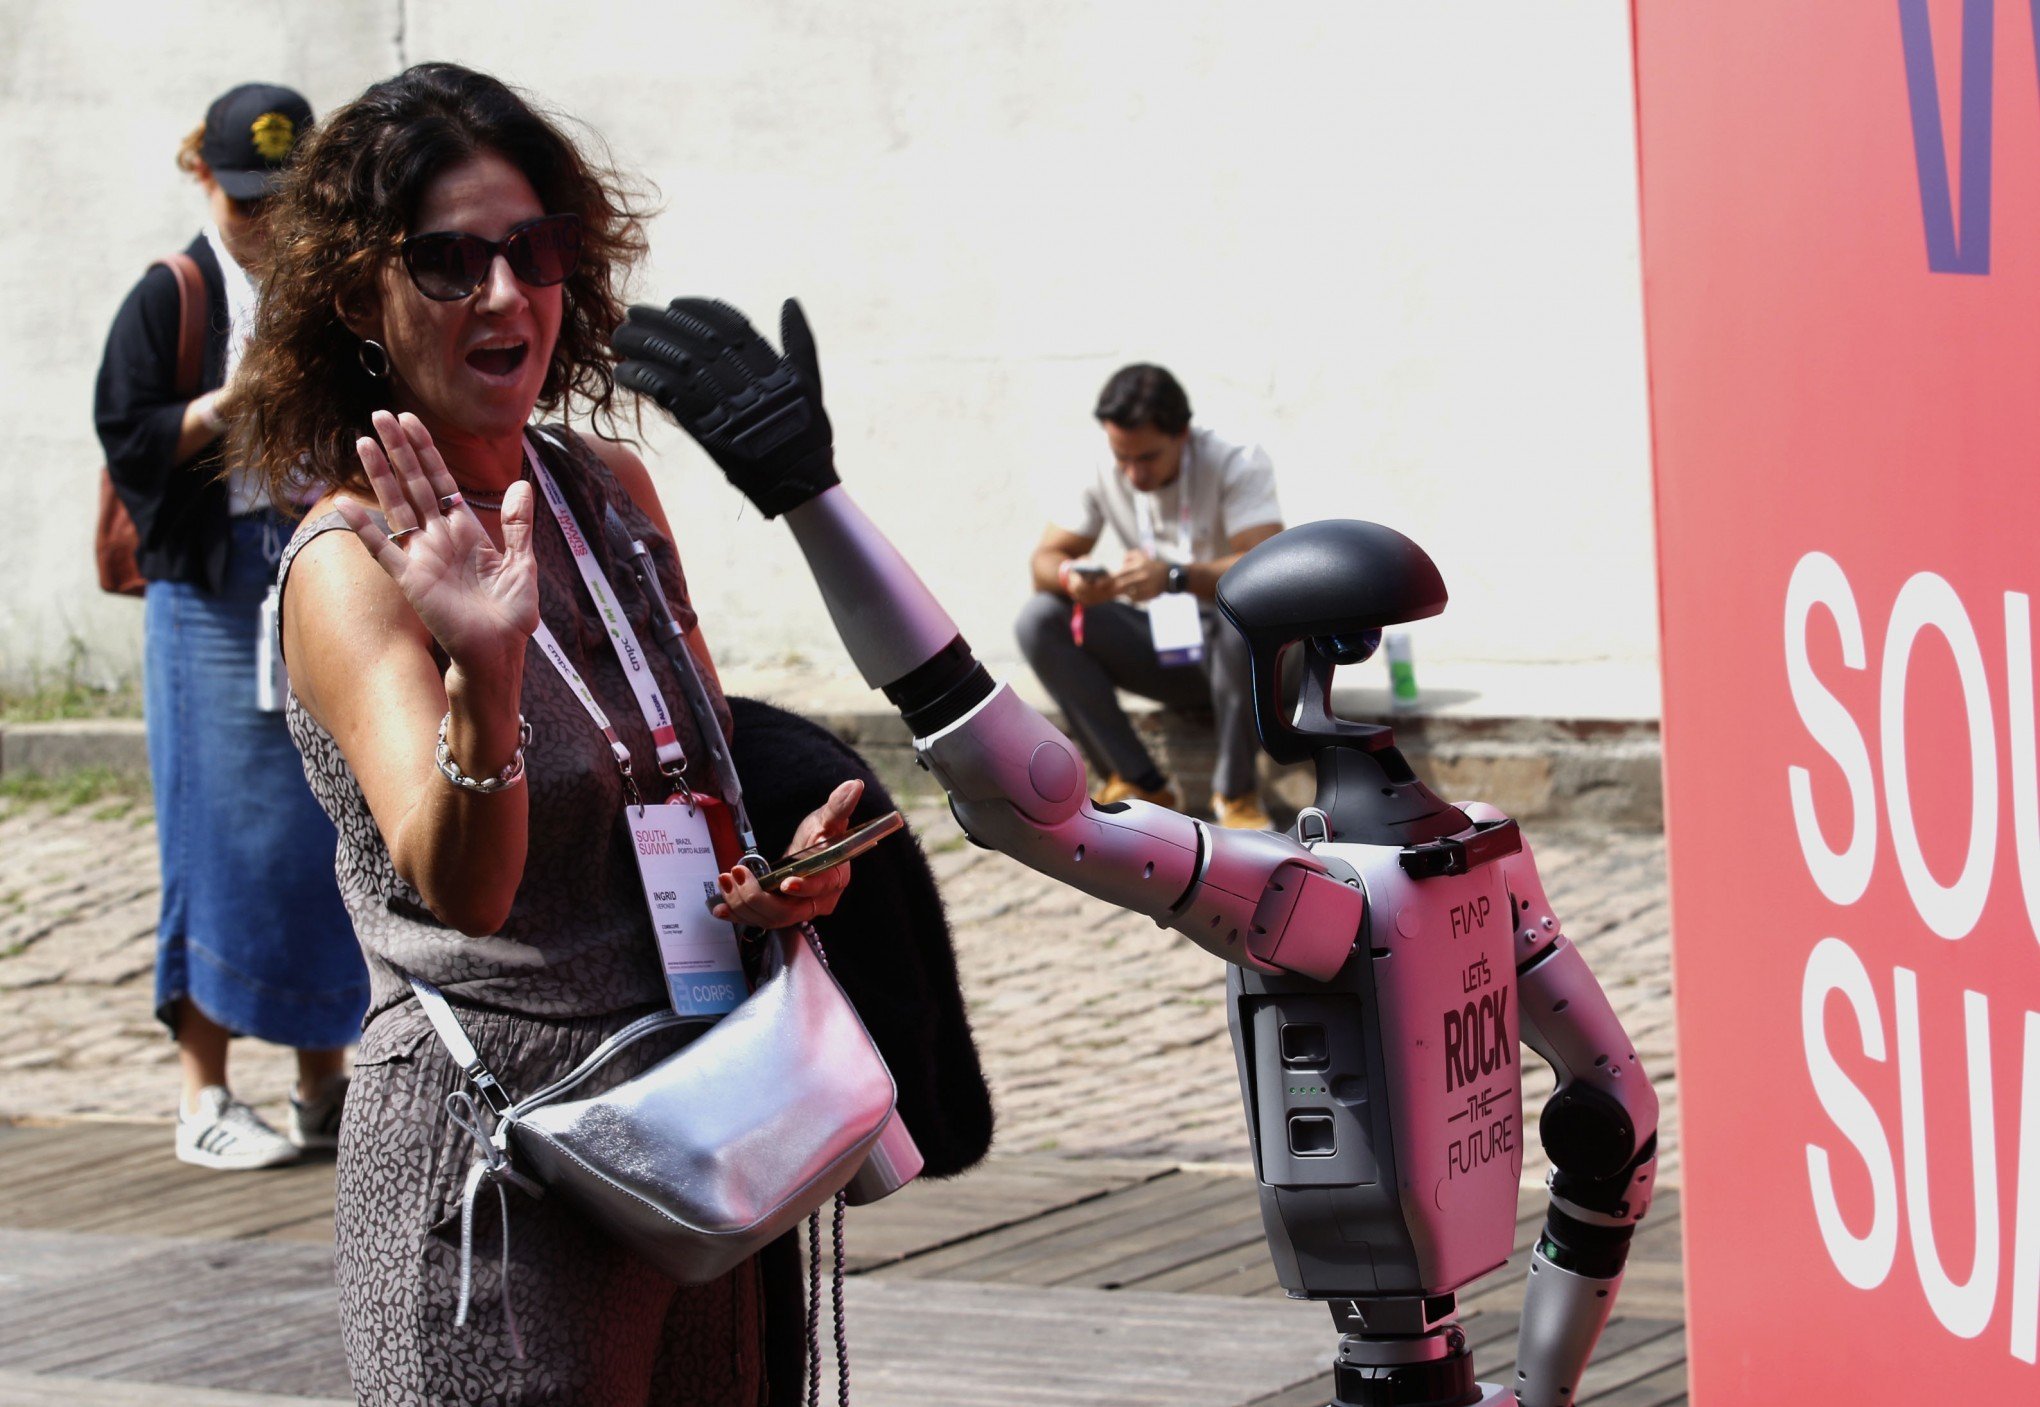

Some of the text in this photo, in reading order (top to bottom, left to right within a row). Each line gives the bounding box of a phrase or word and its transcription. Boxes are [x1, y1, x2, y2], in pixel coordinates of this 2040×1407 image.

[547, 644, 571, 675] cmpc
[621, 638, 640, 672] cmpc
[635, 830, 668, 843] SOUTH
[653, 891, 677, 901] INGRID
[1450, 896, 1490, 939] FIAP
[692, 984, 735, 1002] CORPS
[1443, 985, 1511, 1093] ROCK
[1467, 1088, 1492, 1123] THE
[1449, 1114, 1513, 1180] FUTURE
[1802, 937, 2040, 1365] SU
